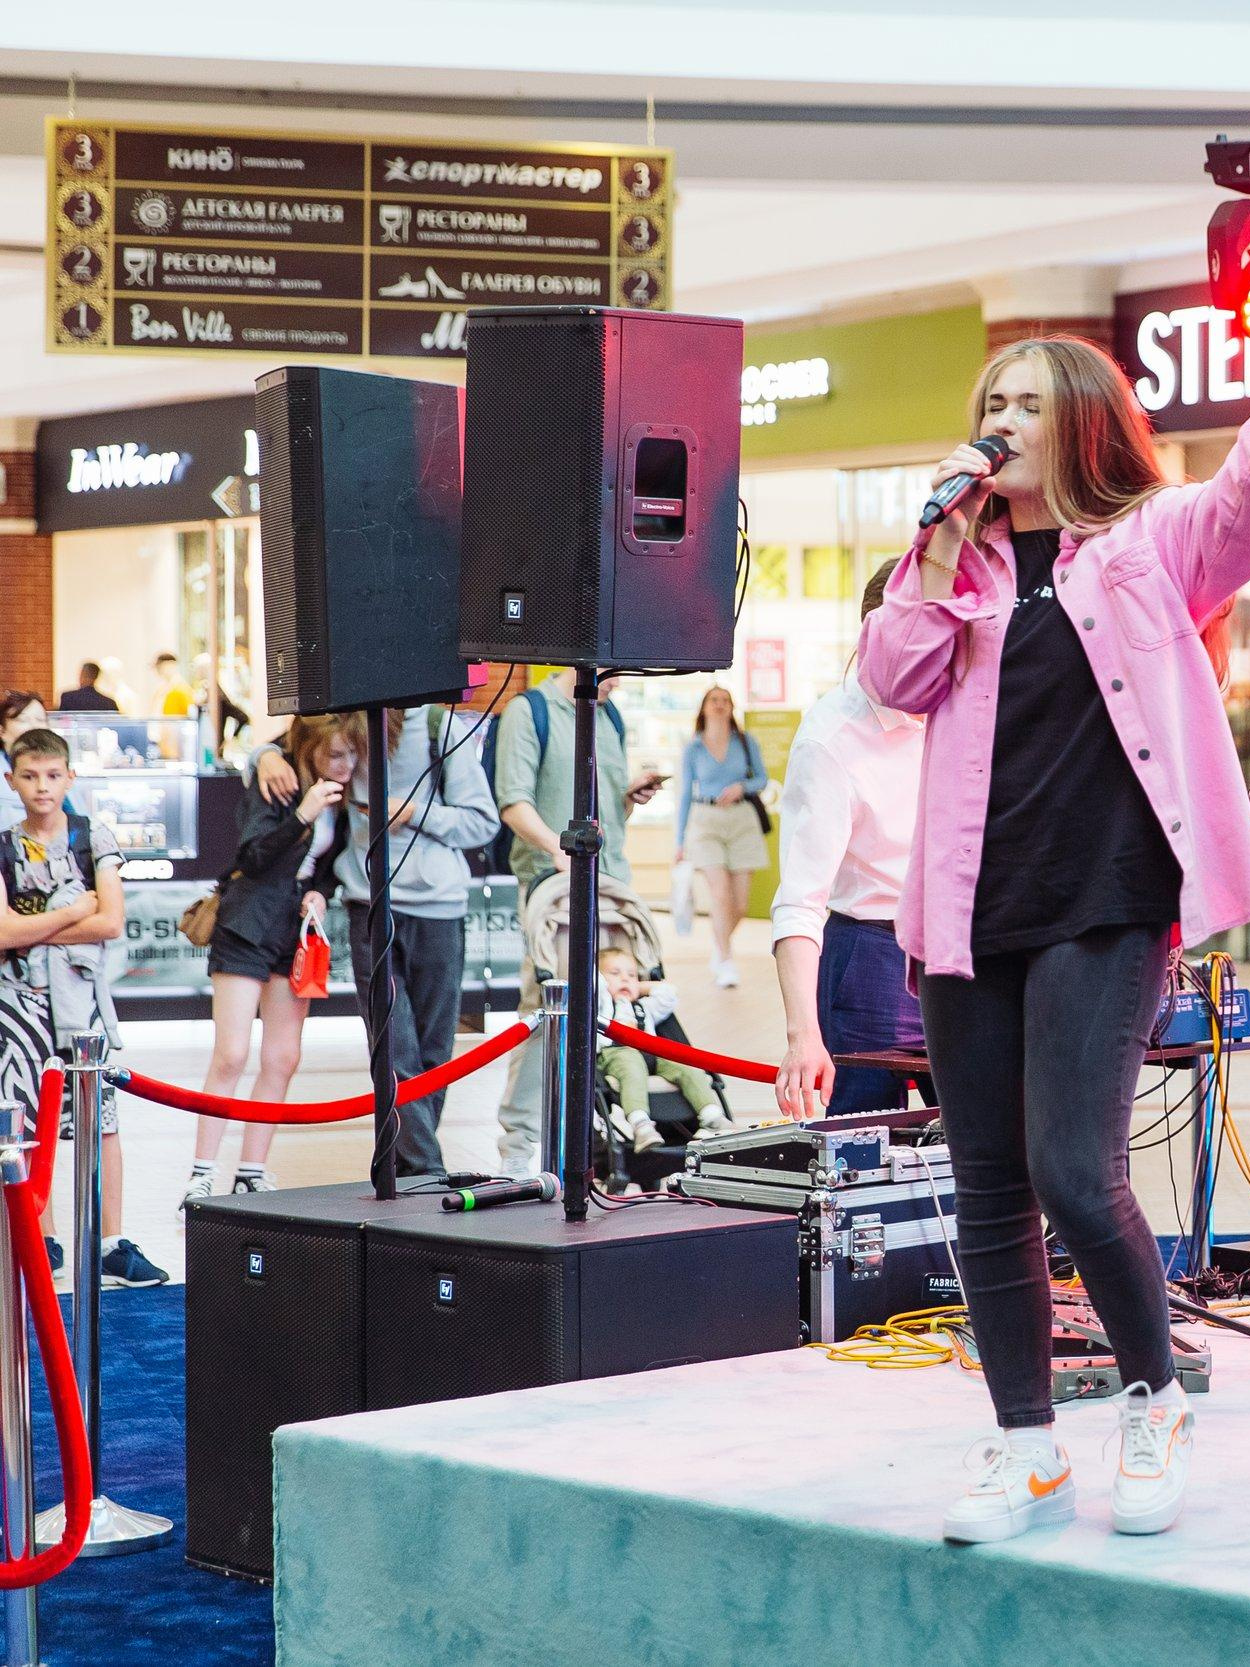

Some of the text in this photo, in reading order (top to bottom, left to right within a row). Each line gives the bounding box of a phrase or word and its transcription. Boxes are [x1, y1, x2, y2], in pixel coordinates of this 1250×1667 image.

[181, 197, 344, 223] ДЕТСКАЯ ГАЛЕРЕЯ
[416, 208, 528, 232] РЕСТОРАНЫ
[162, 251, 277, 275] РЕСТОРАНЫ
[461, 271, 601, 296] ГАЛЕРЕЯ ОБУВИ
[129, 303, 234, 343] Bon Ville
